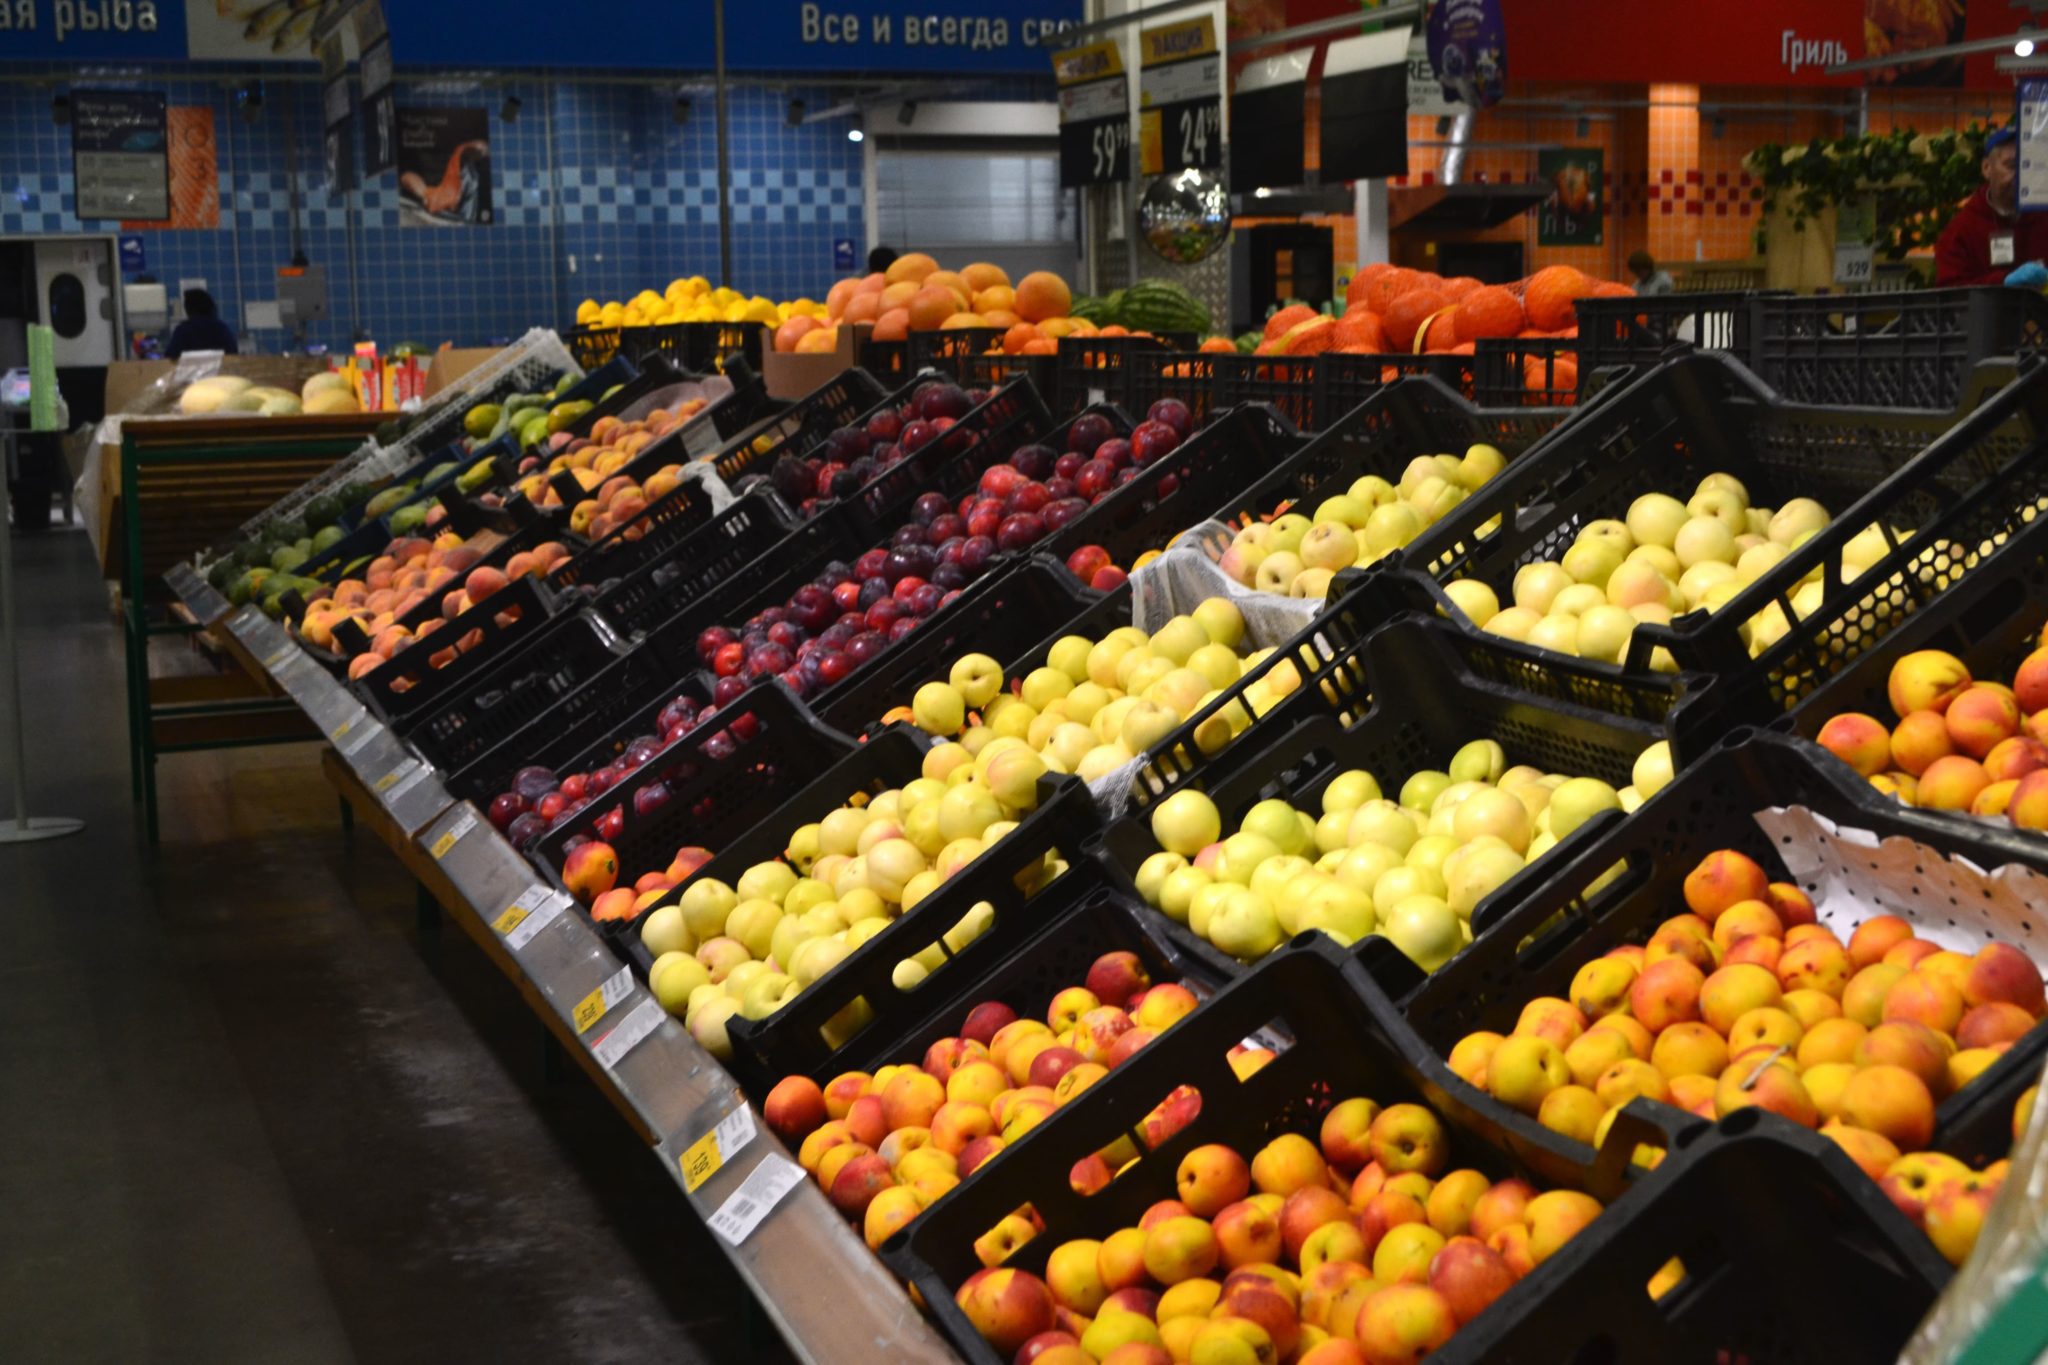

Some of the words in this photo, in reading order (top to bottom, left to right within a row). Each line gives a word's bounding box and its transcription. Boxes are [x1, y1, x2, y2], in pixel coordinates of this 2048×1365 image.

[55, 0, 158, 42] рыба
[801, 3, 859, 43] Все
[873, 16, 891, 43] и
[904, 17, 1009, 49] всегда
[1781, 30, 1848, 74] Гриль
